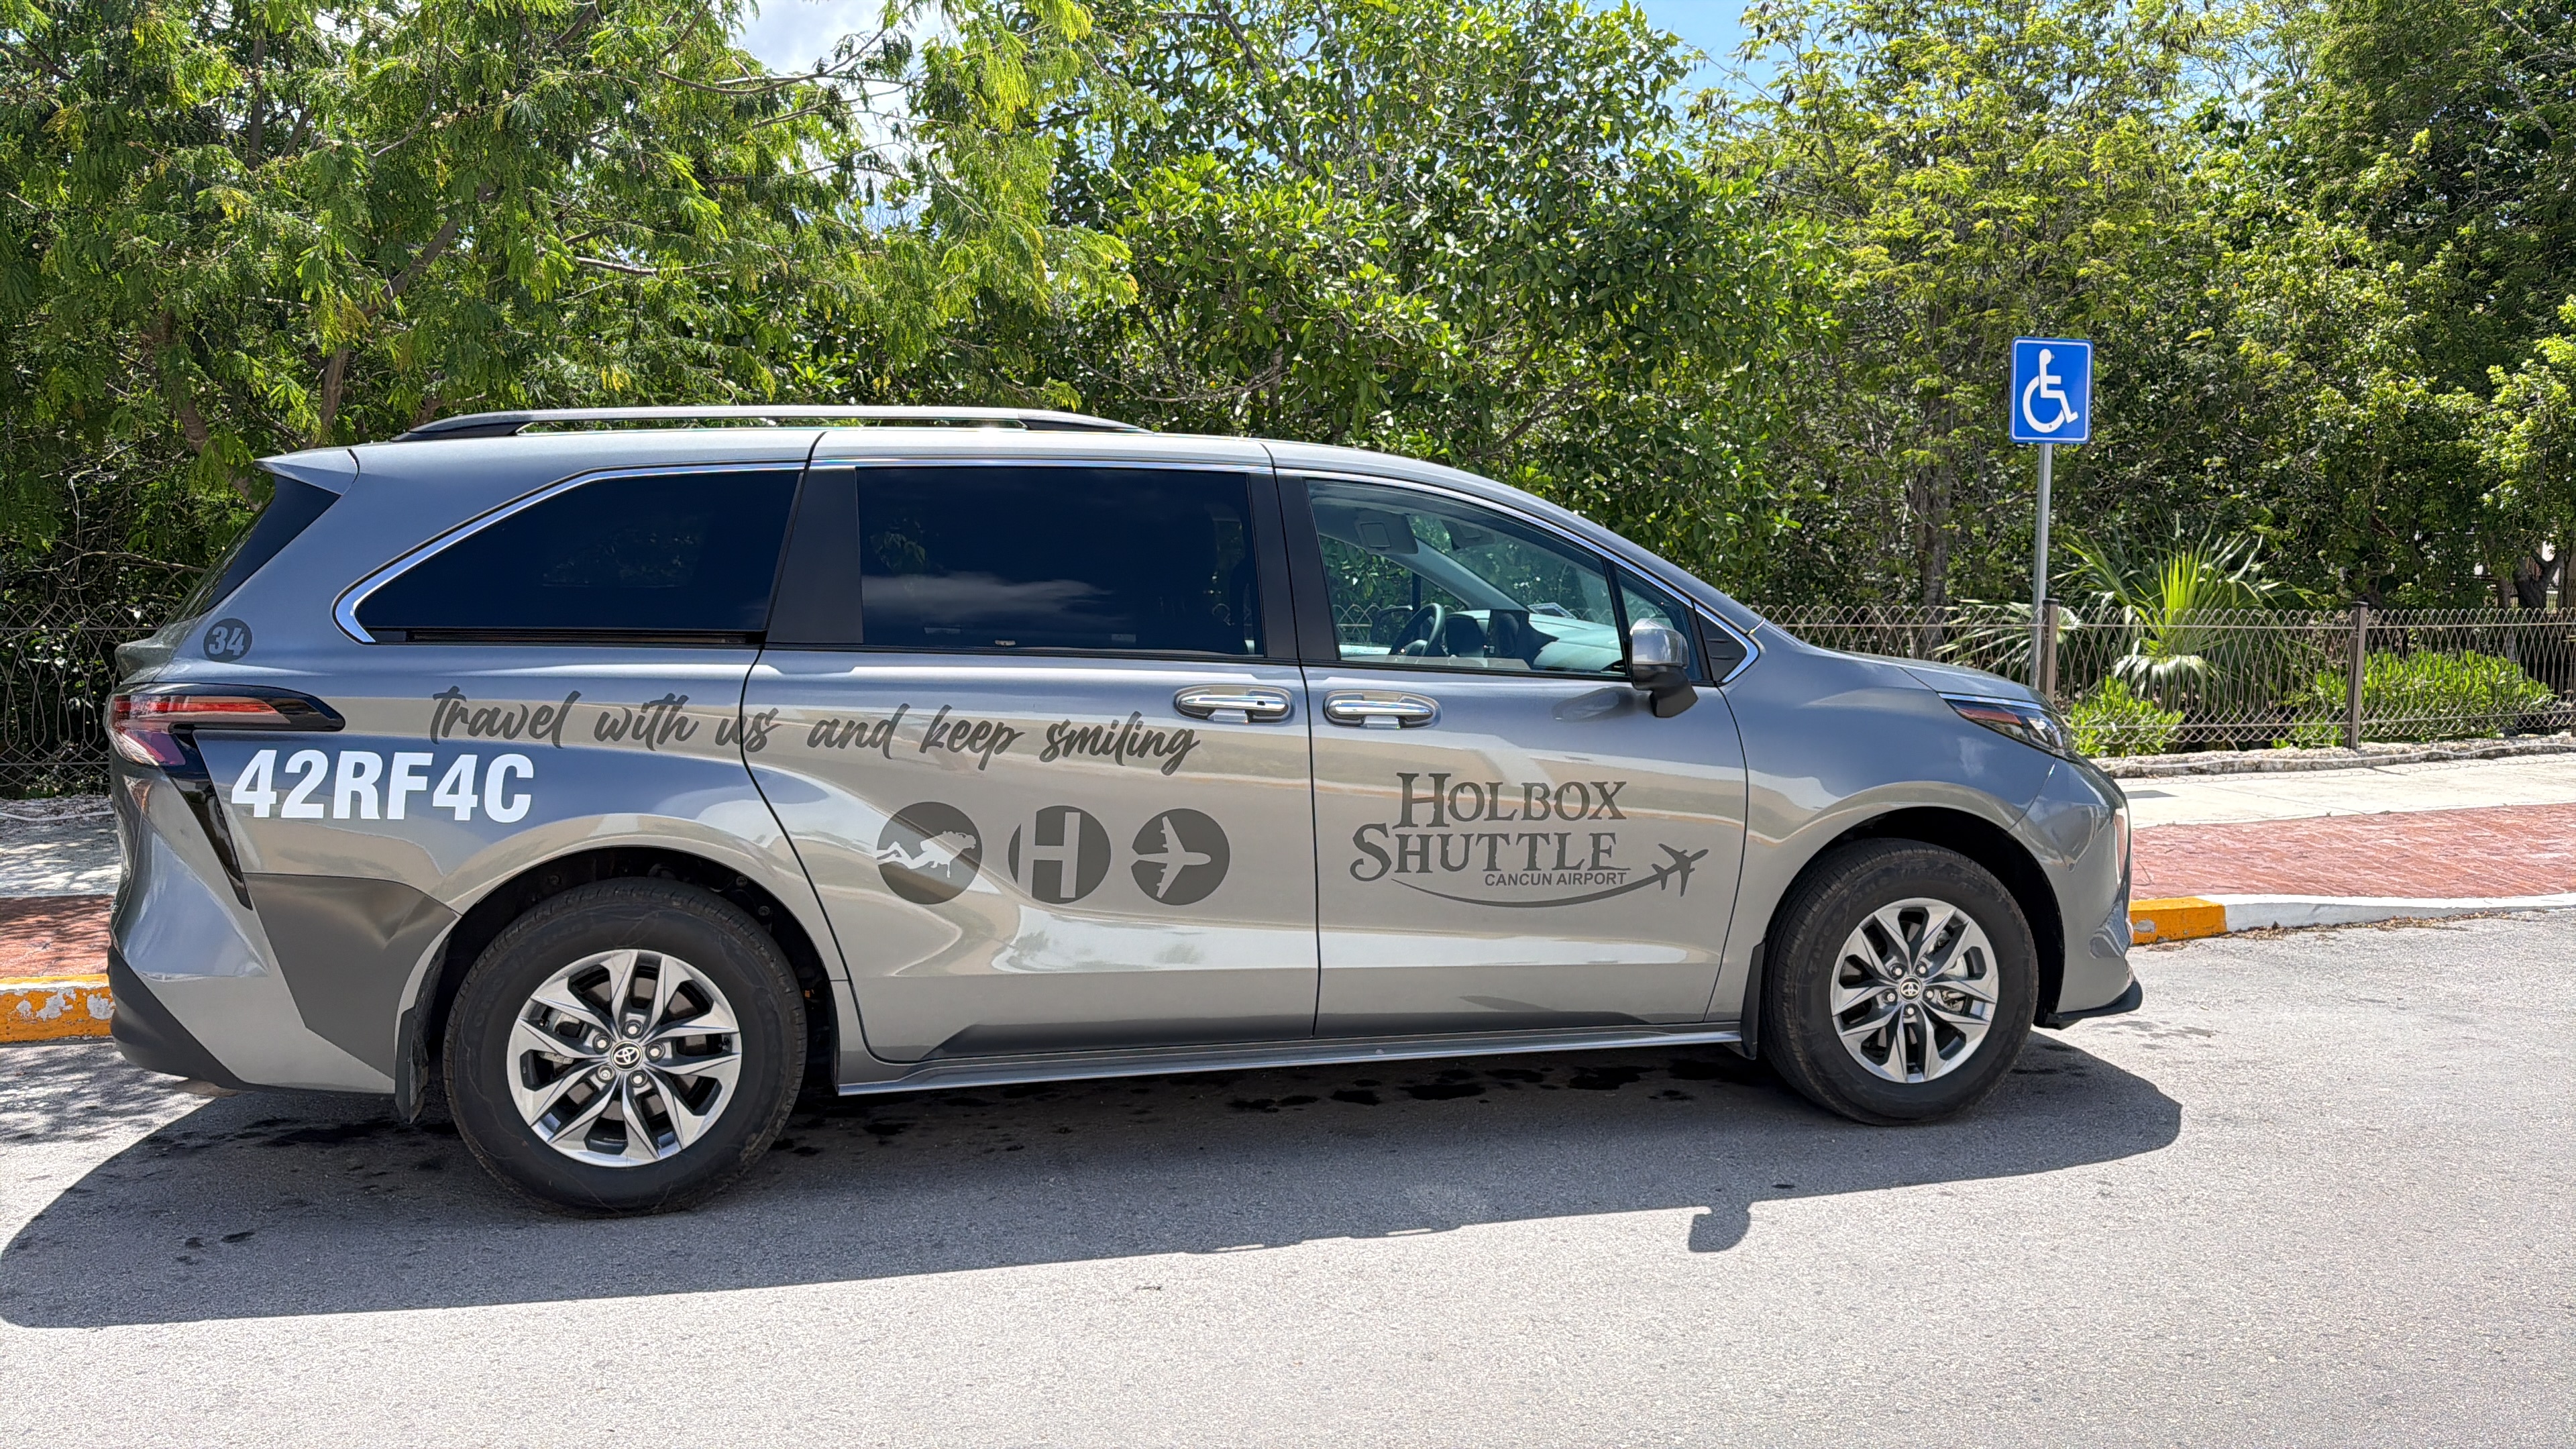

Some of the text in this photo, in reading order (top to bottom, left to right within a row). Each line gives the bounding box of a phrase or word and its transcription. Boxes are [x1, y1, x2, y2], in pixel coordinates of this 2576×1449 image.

[208, 627, 246, 656] 34
[429, 686, 1200, 775] travel with us and keep smiling
[231, 749, 535, 824] 42RF4C
[1392, 771, 1627, 830] HOLBOX
[1349, 822, 1631, 882] SHUTTLE
[1485, 871, 1627, 887] CANCUN AIRPORT
